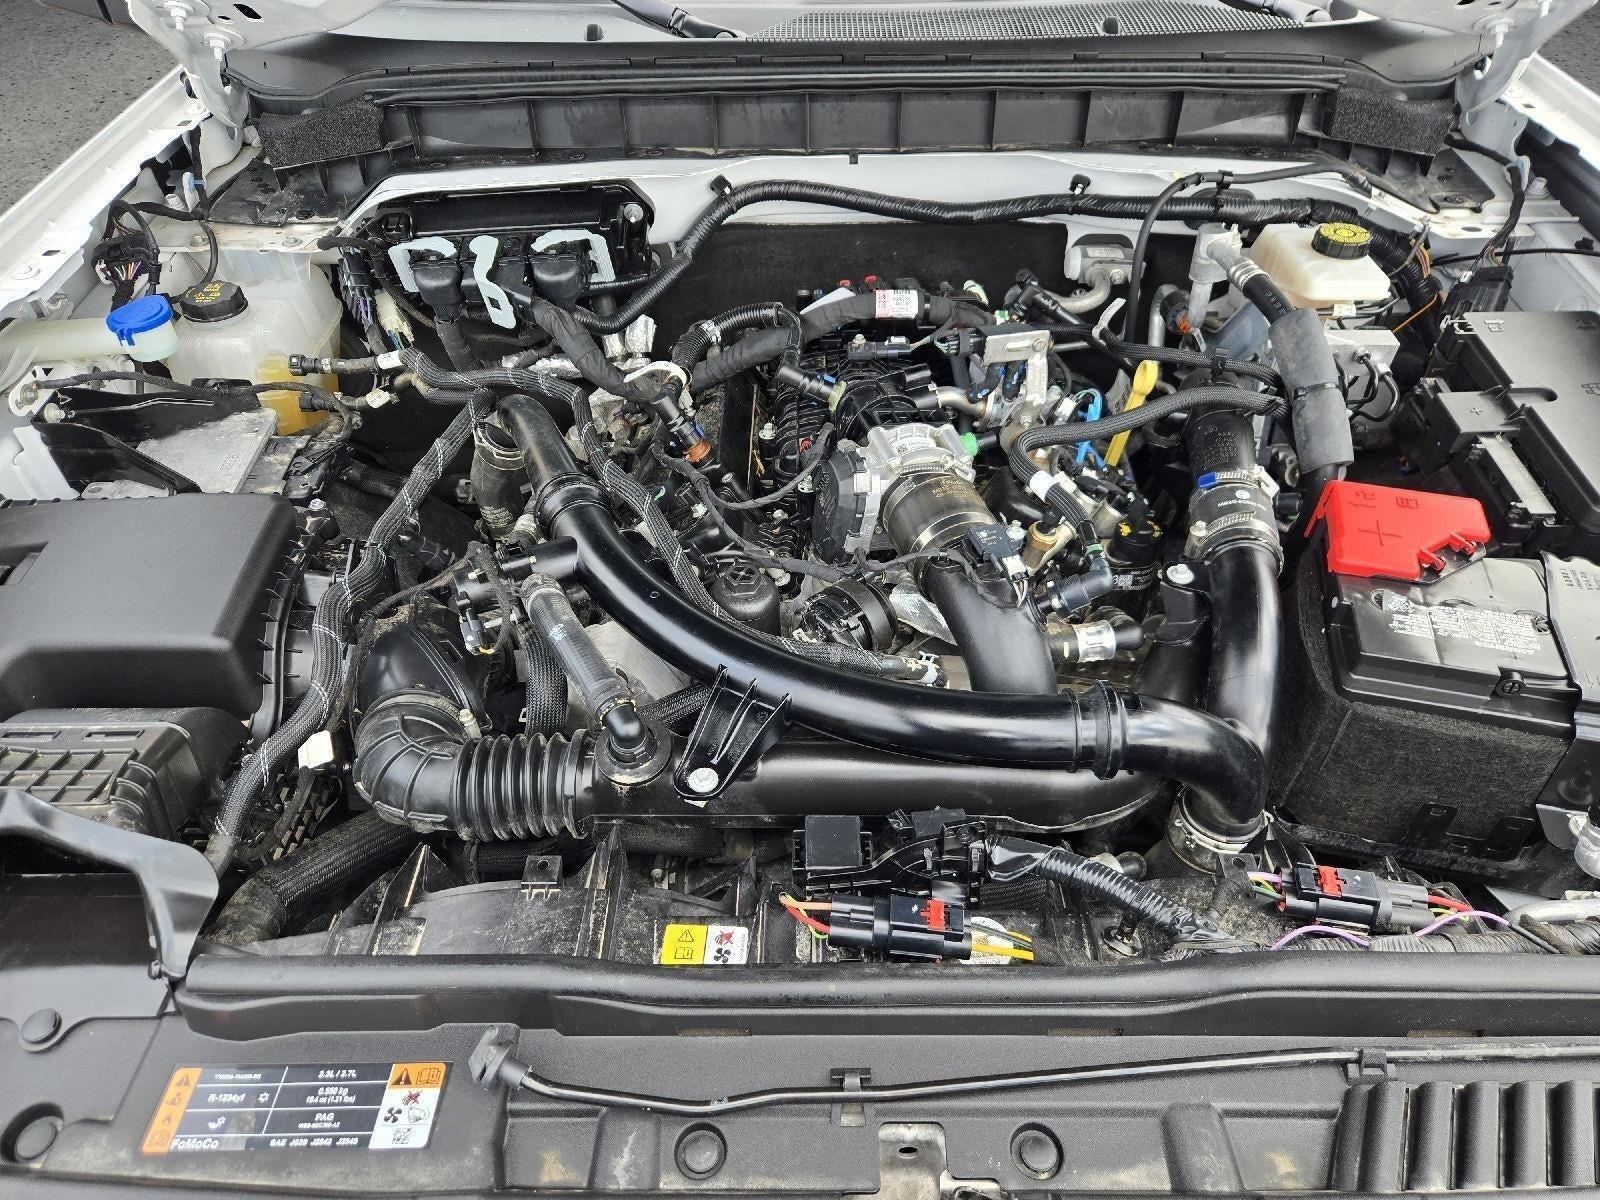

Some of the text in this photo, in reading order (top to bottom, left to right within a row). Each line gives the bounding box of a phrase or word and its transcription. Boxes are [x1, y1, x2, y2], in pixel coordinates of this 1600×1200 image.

[338, 1086, 349, 1097] kg
[314, 1112, 335, 1122] PAG
[170, 1137, 219, 1150] FoMoCo
[269, 1138, 287, 1147] SAE
